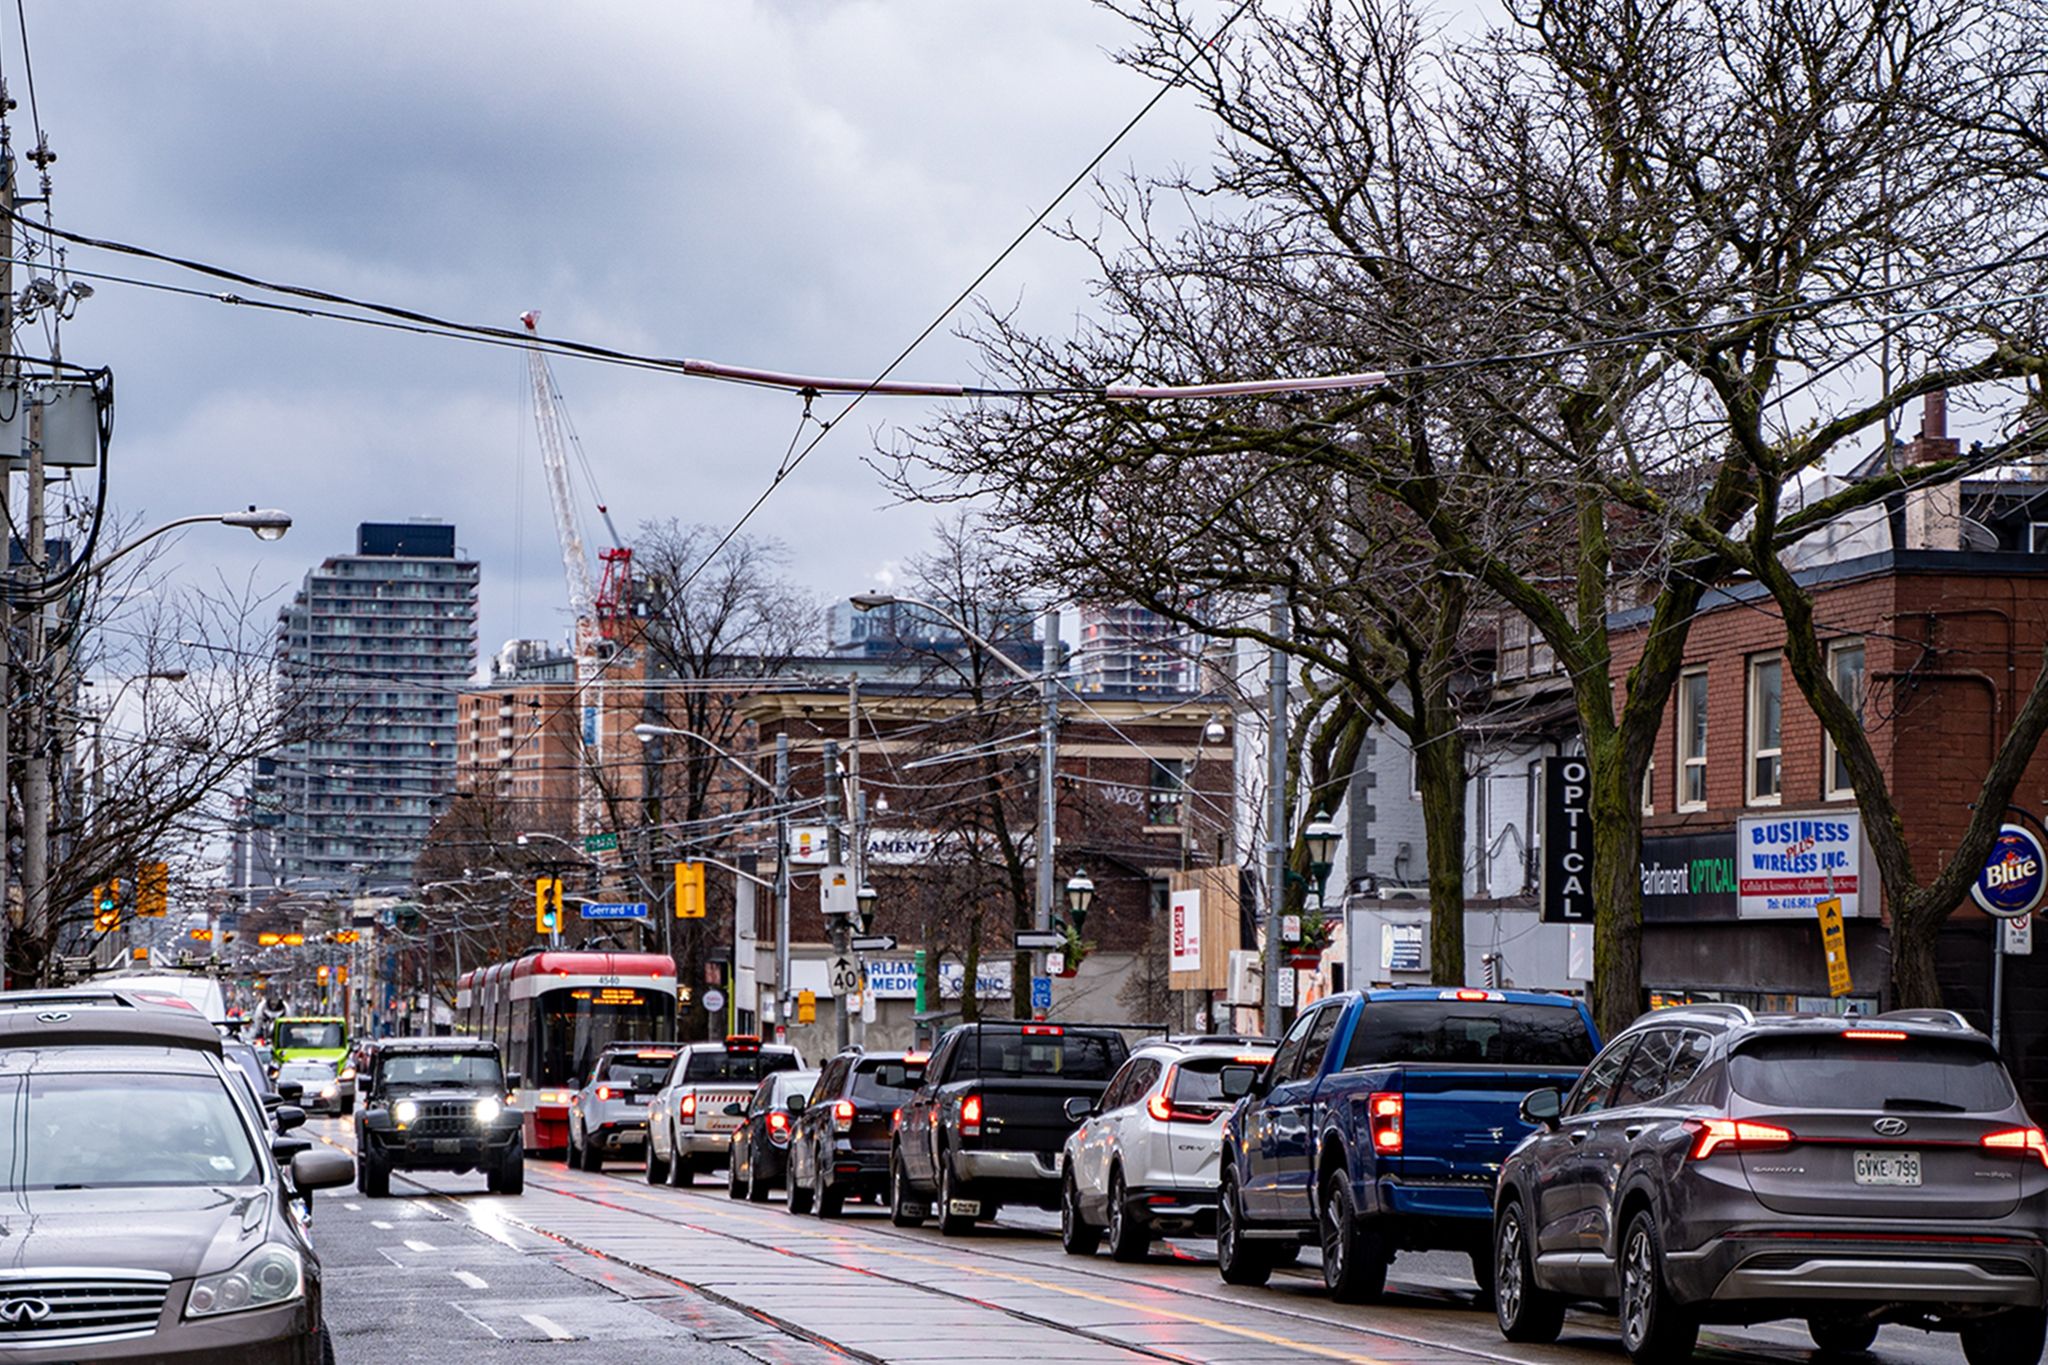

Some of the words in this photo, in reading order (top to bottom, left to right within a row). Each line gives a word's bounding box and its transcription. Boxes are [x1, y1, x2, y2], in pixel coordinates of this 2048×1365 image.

[1562, 762, 1586, 917] OPTICAL
[1752, 821, 1850, 845] BUSINESS
[1785, 836, 1815, 859] PLUS
[1752, 852, 1818, 874] WIRELESS
[1821, 851, 1850, 870] INC.
[1986, 860, 2037, 888] Blue
[1690, 857, 1737, 894] OPTICAL
[588, 904, 624, 915] Gerrard
[633, 903, 639, 915] E
[598, 976, 620, 985] 4540
[833, 970, 857, 990] 40
[1177, 1143, 1206, 1152] CR-V
[1856, 1158, 1888, 1177] GVKE
[1894, 1159, 1919, 1178] 799
